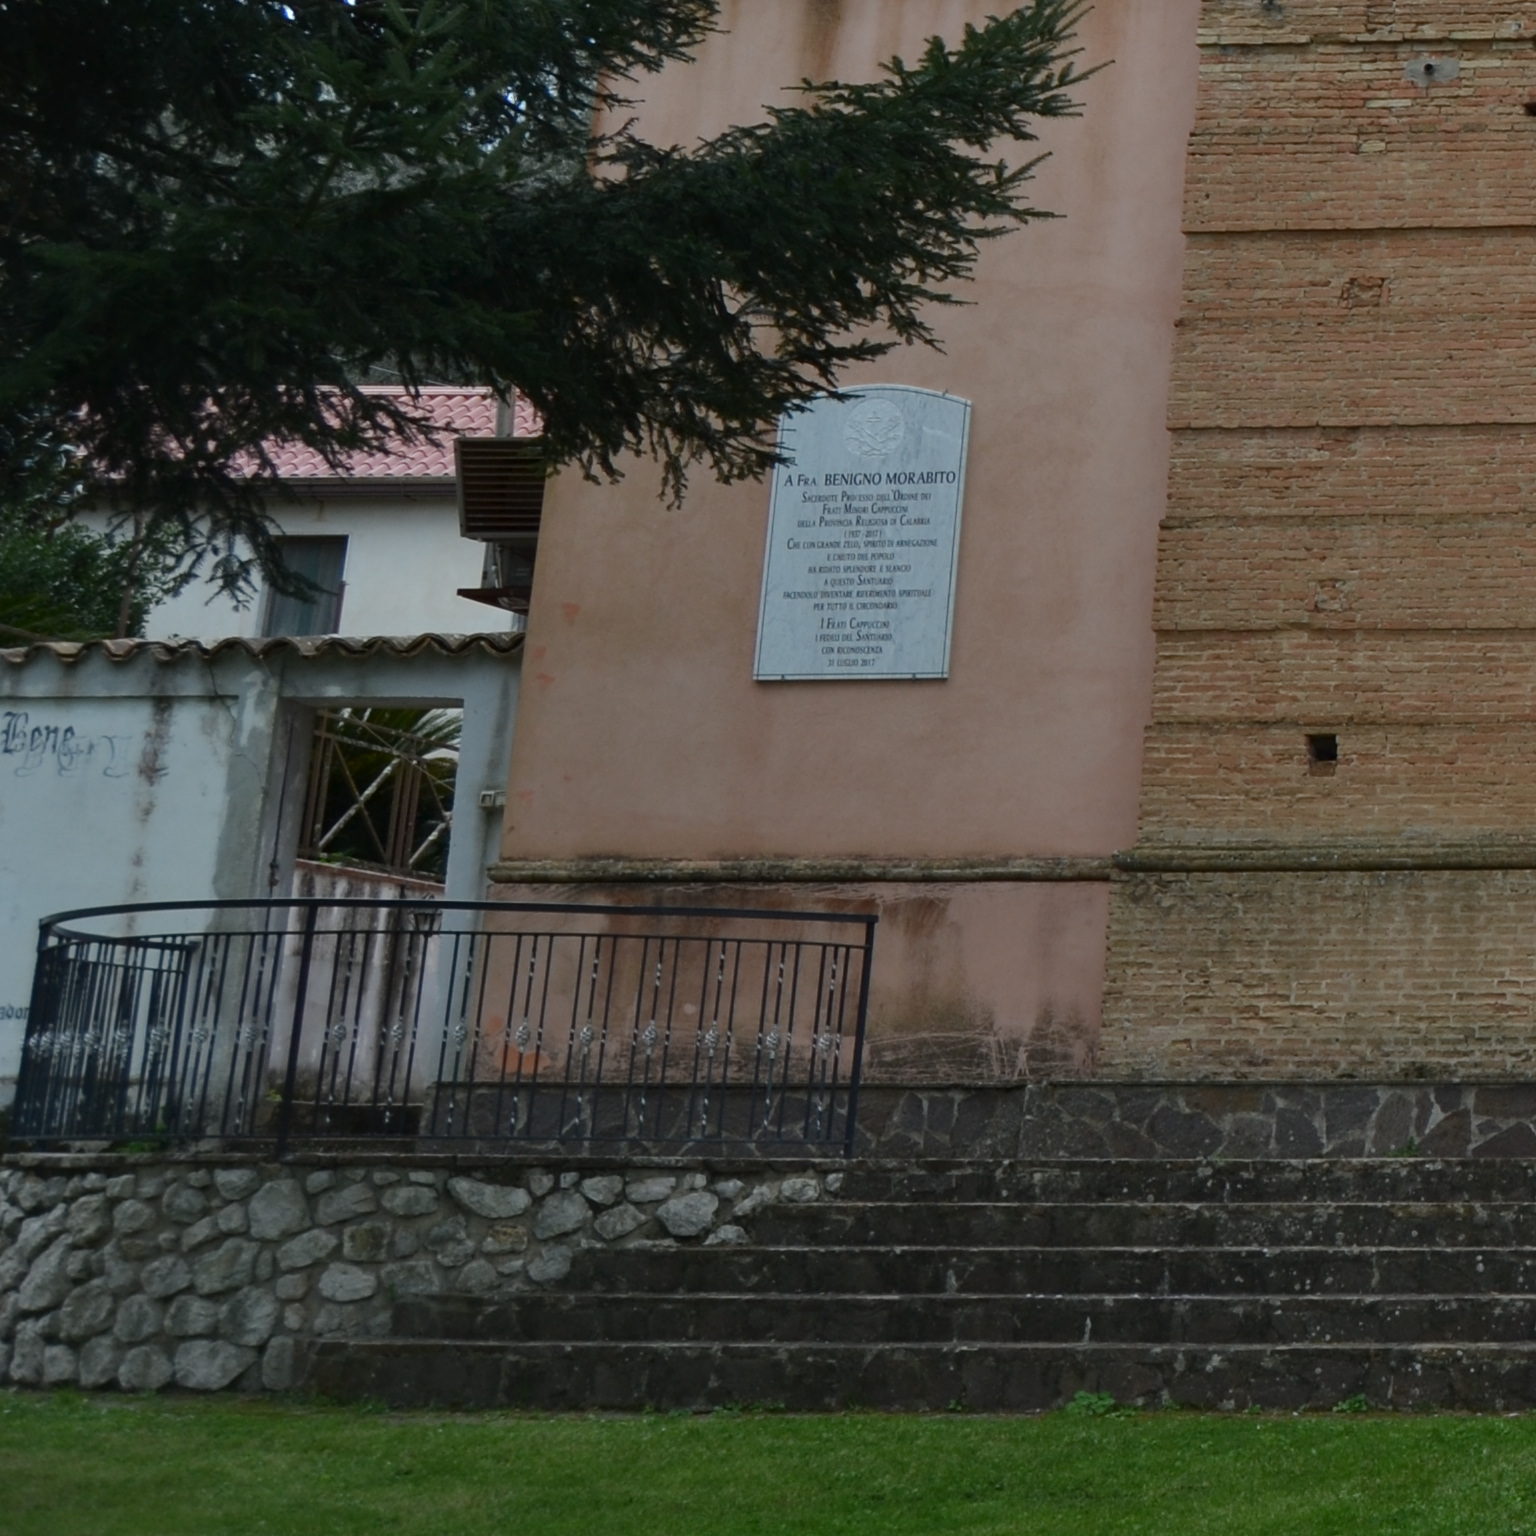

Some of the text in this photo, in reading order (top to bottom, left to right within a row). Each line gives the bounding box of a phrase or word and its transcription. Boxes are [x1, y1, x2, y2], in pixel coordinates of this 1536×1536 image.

[784, 471, 956, 486] A FRA BENIGNO MORABITO
[870, 553, 895, 561] POPOLO
[820, 617, 825, 629] I
[856, 629, 893, 642] SANTUARIO
